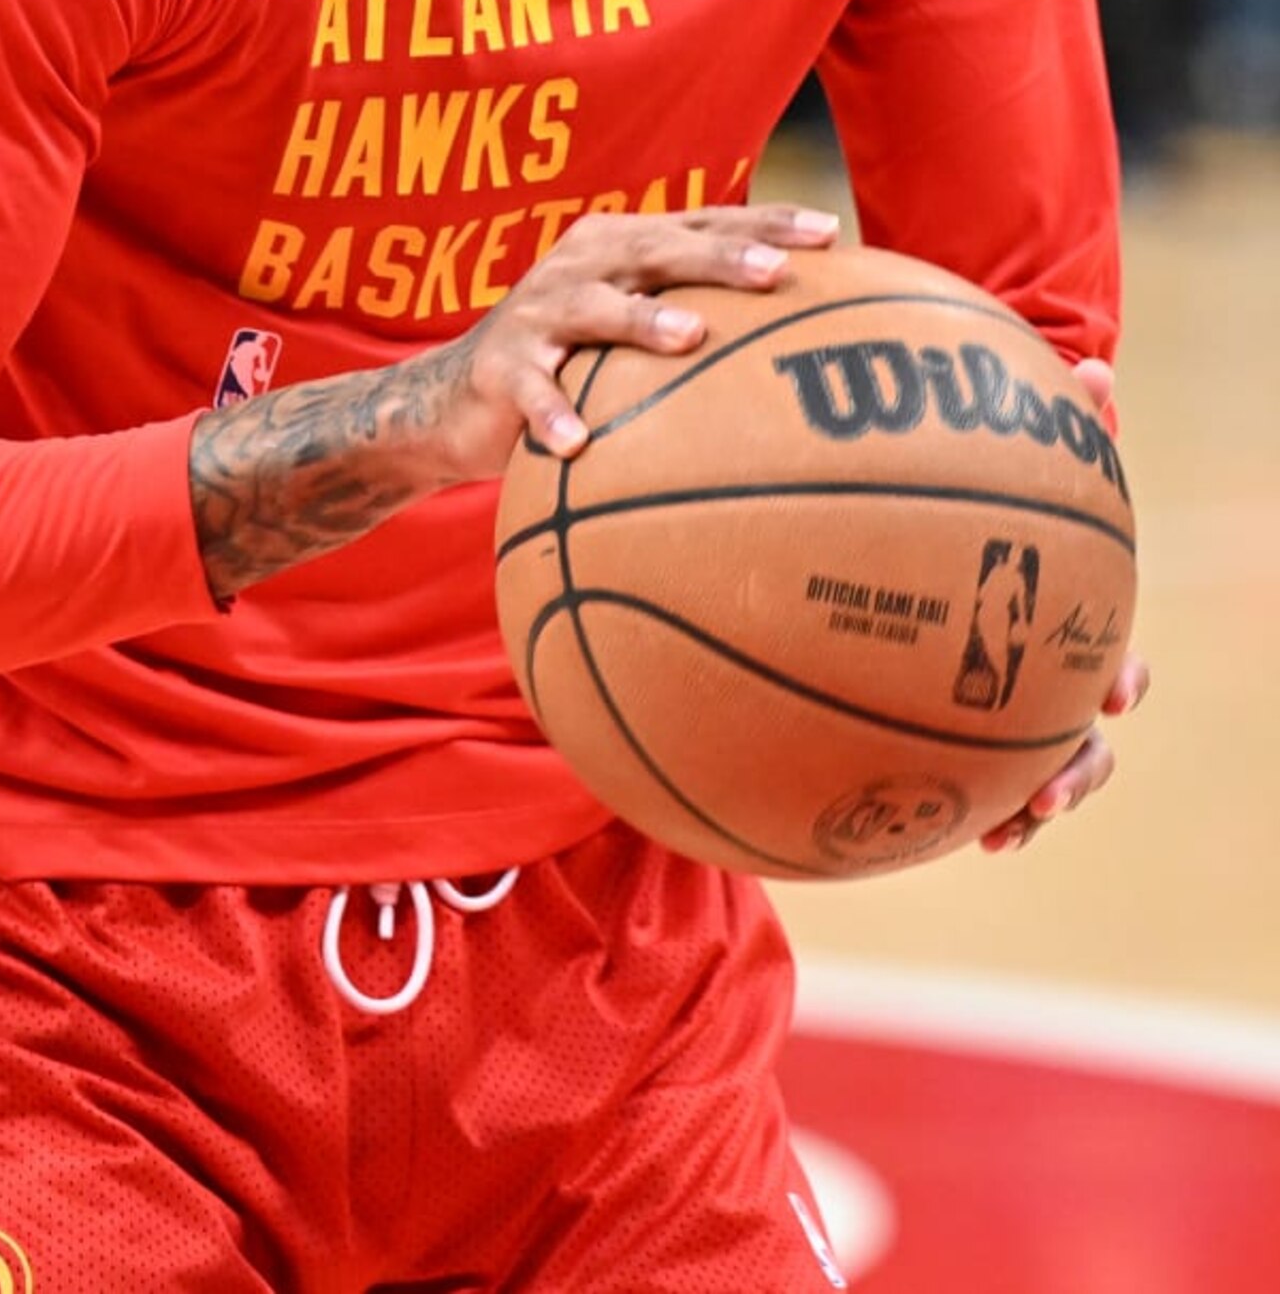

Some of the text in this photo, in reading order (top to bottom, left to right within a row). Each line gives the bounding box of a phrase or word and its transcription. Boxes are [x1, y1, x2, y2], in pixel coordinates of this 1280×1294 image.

[272, 77, 579, 198] HAWKS
[237, 158, 750, 320] BASKET
[772, 339, 1131, 505] Wilson
